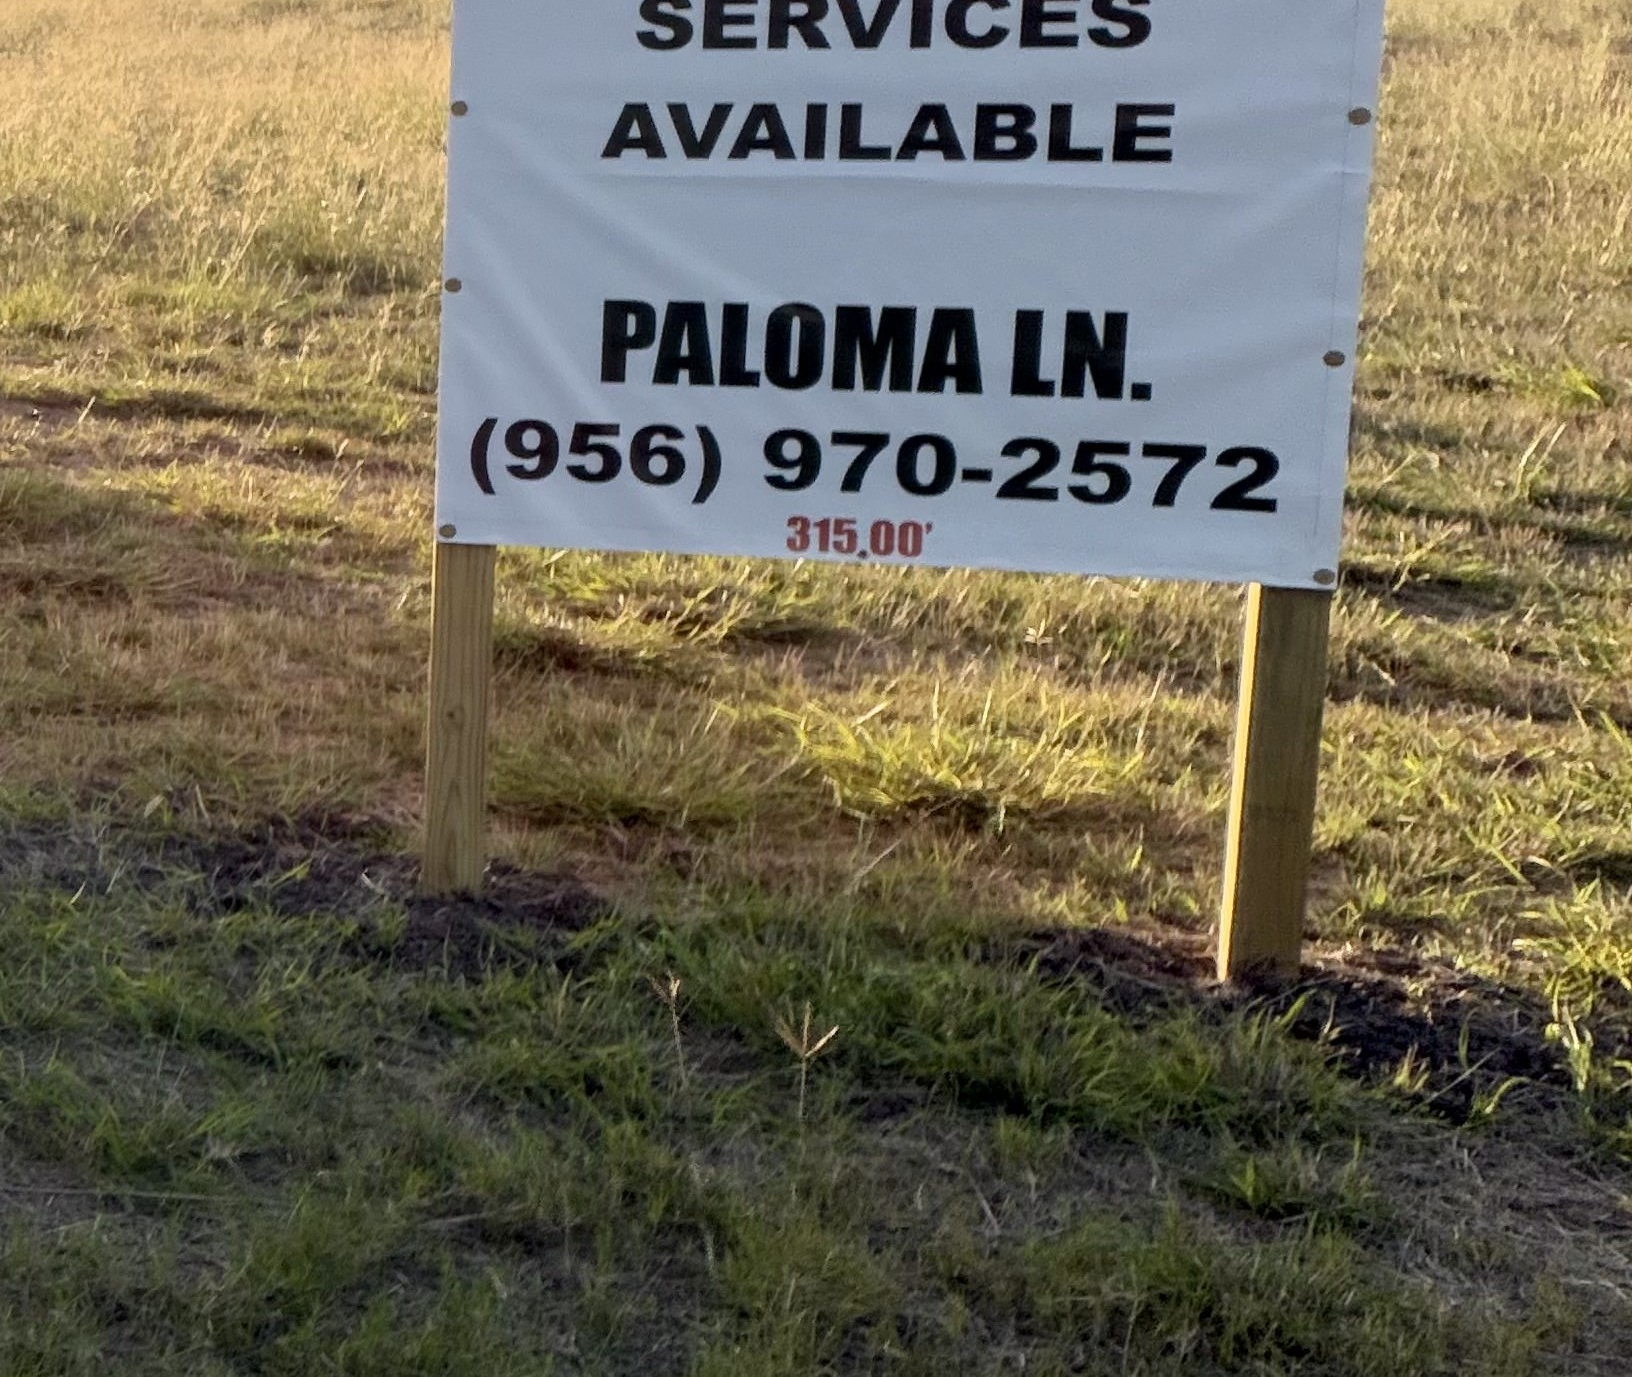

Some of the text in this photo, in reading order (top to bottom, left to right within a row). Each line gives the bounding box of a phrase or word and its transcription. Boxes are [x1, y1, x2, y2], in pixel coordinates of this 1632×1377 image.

[600, 103, 1176, 163] AVAILABLE
[600, 299, 1153, 401] PALOMA LN.
[470, 417, 1280, 513] (956) 970-2572
